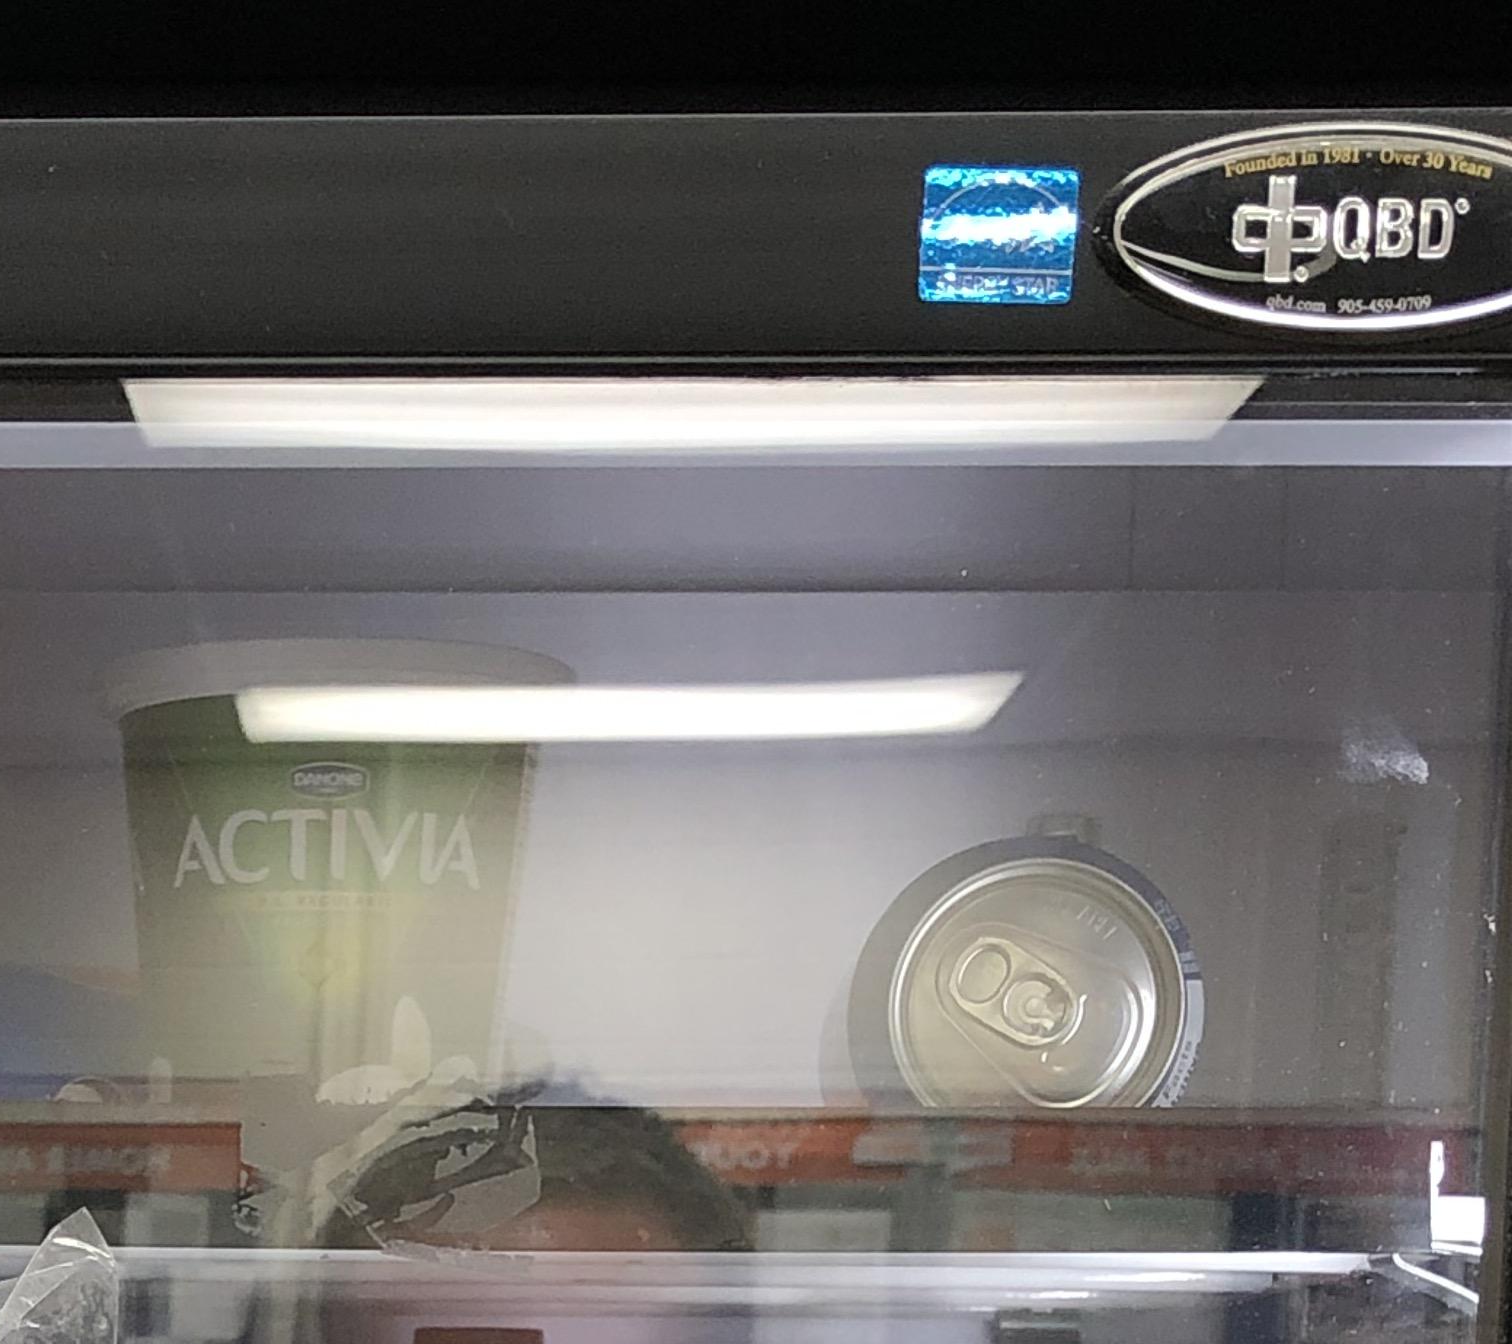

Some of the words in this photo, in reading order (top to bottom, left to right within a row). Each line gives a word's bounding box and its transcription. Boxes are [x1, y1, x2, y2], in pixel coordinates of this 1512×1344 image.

[1224, 150, 1297, 178] Founded
[1300, 149, 1318, 165] in
[1323, 147, 1361, 164] 1981
[1379, 150, 1420, 167] Over
[1423, 151, 1445, 170] 30
[1448, 154, 1493, 180] Years
[1265, 294, 1327, 314] qbd.com
[1337, 295, 1433, 314] 905-459-0709
[293, 771, 364, 788] DANONE
[174, 807, 481, 891] ACTIVIA
